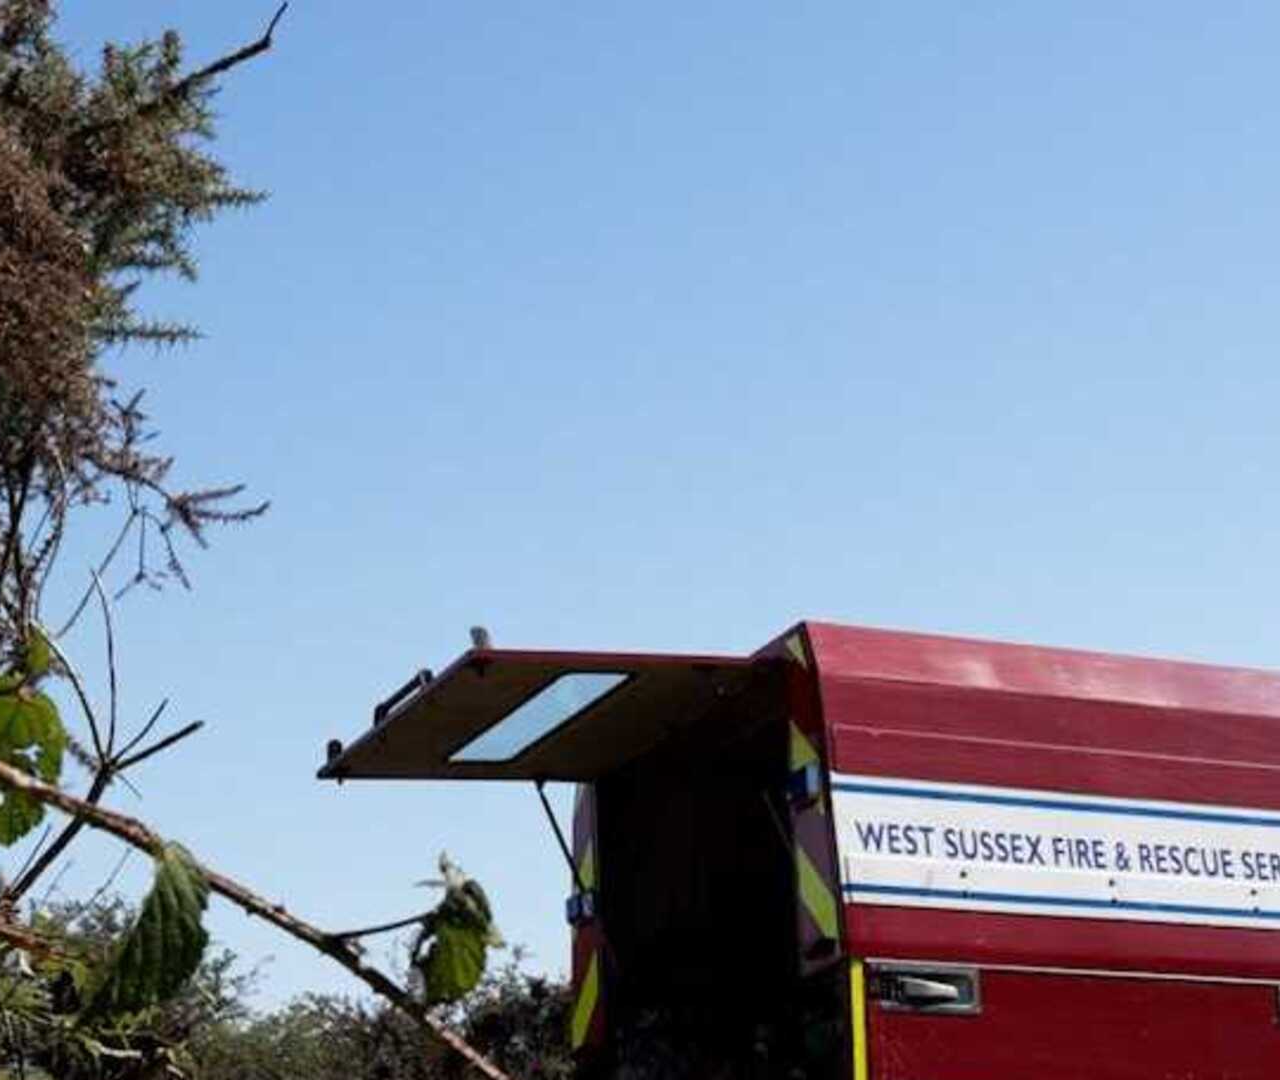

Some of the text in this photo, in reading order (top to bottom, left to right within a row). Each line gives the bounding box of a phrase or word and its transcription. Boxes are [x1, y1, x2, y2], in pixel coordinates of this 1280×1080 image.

[855, 821, 935, 857] WEST
[943, 828, 1046, 866] SUSSEX
[1052, 837, 1108, 869] FIRE
[1116, 842, 1131, 871] &
[1138, 844, 1235, 879] RESCUE
